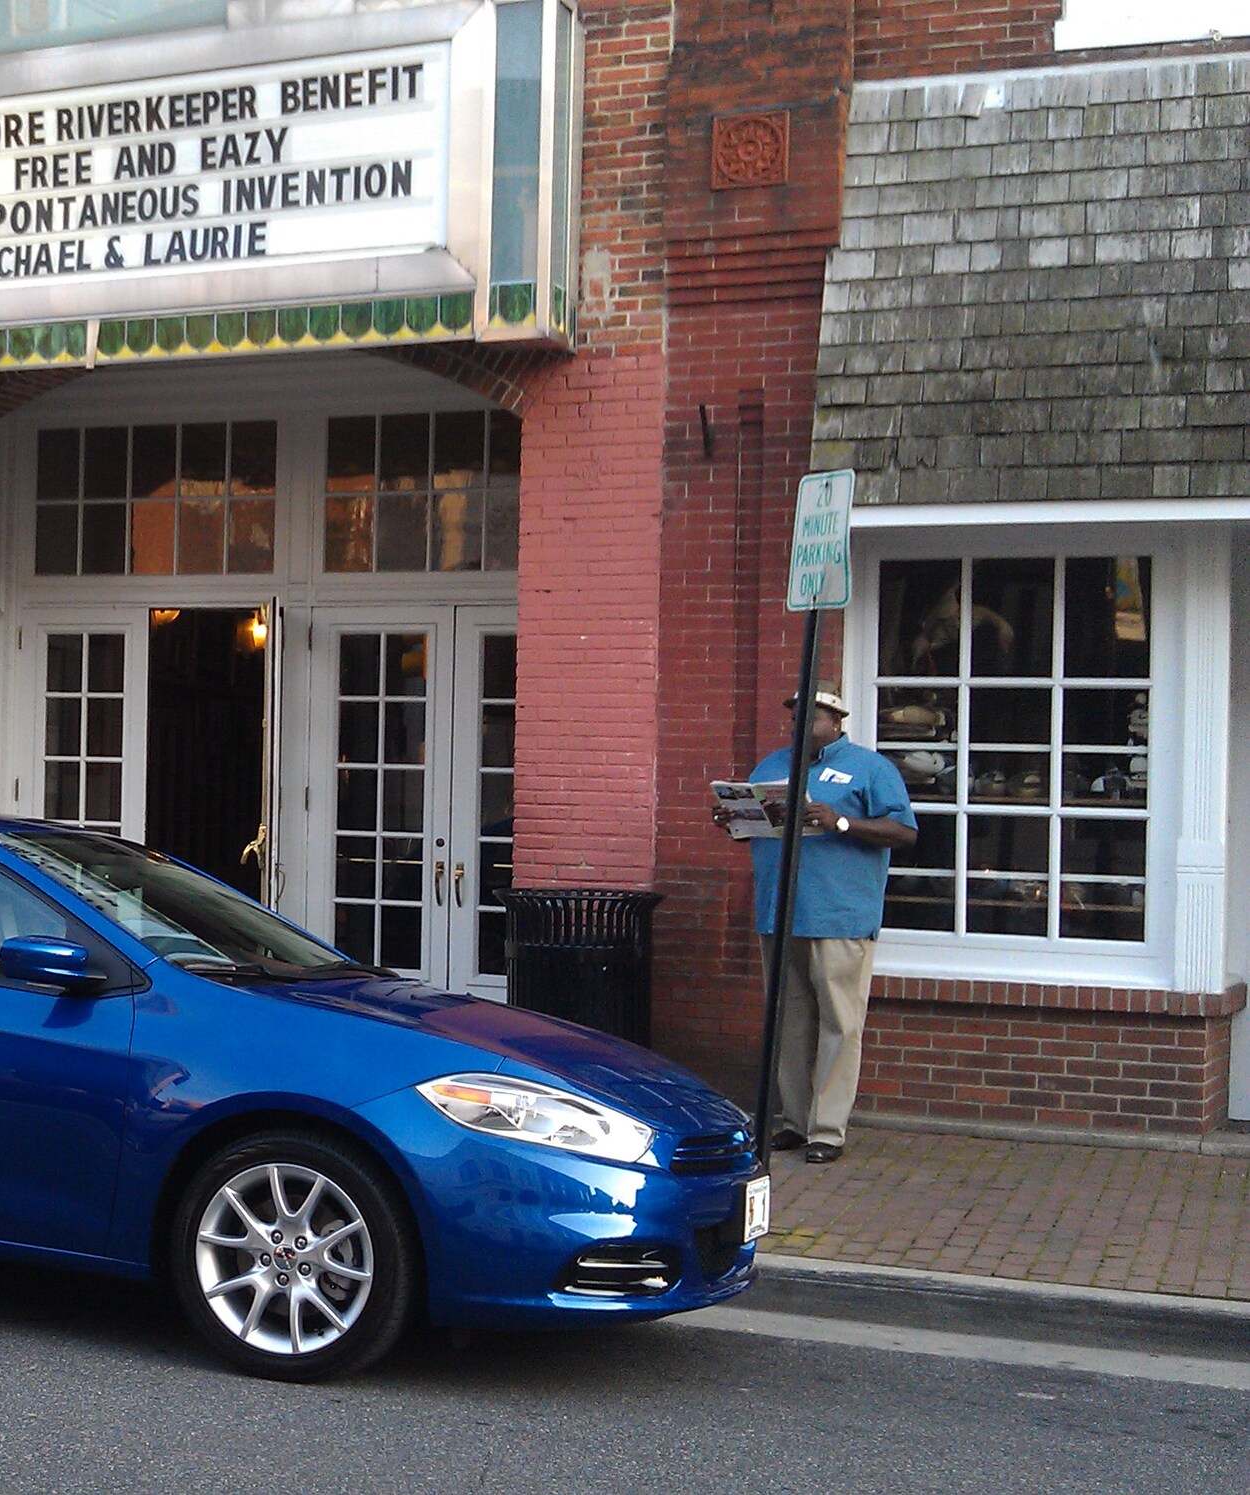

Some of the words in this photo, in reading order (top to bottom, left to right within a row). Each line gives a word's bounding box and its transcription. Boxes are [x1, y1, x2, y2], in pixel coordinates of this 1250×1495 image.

[57, 85, 257, 141] RIVERKEEPER
[280, 64, 423, 115] BENEFIT
[15, 150, 92, 191] FREE
[114, 142, 177, 180] AND
[200, 127, 288, 171] EAZY
[222, 160, 413, 214] INVENTION
[104, 235, 124, 270] &
[143, 221, 267, 267] LAURIE
[817, 480, 832, 508] 20
[803, 512, 839, 536] MINUTE
[796, 541, 842, 567] PARKING
[801, 568, 826, 596] ONLY
